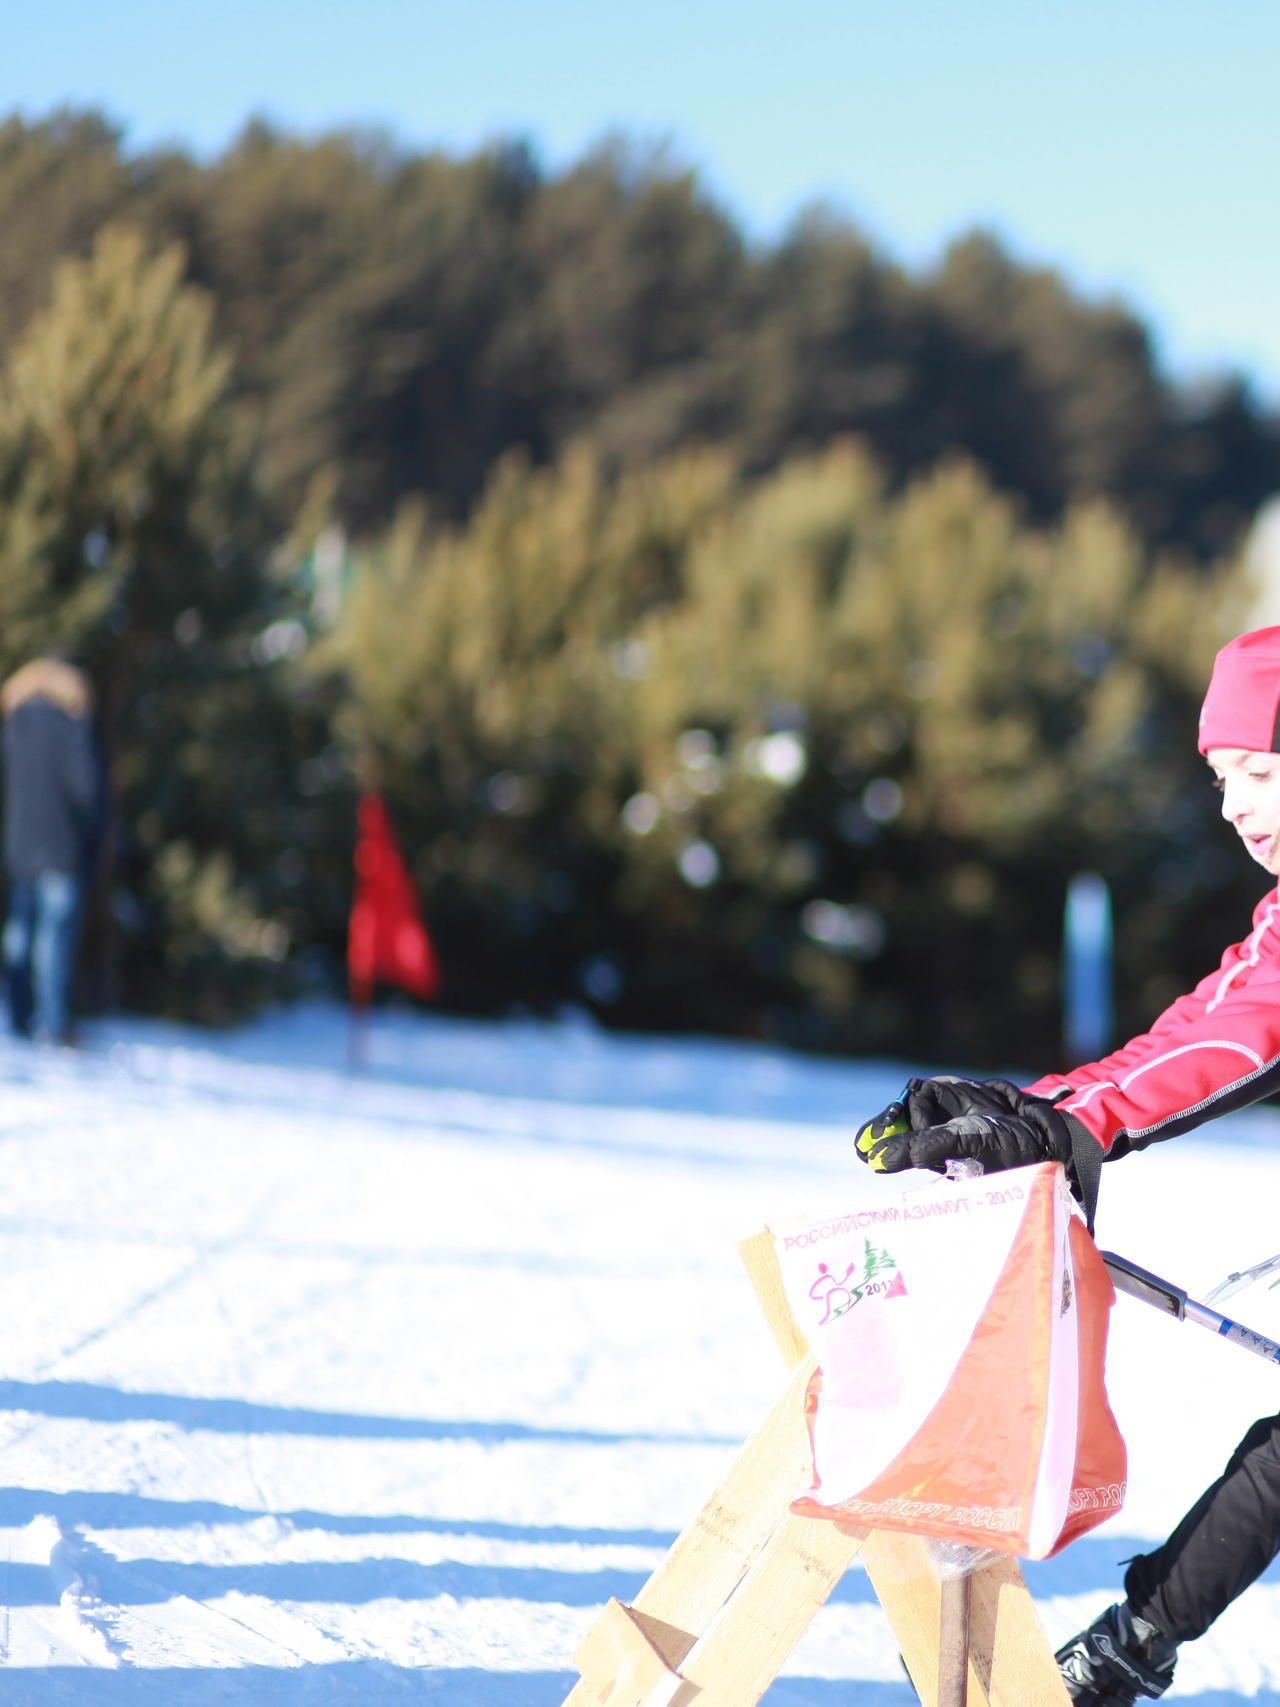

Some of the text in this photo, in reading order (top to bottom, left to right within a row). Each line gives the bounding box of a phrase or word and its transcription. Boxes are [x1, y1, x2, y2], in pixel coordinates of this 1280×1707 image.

[783, 1207, 901, 1251] РОССИЙСКИЙ
[903, 1198, 970, 1221] АЗИМУТ
[985, 1185, 1025, 1206] 2013
[865, 1280, 895, 1296] 2013
